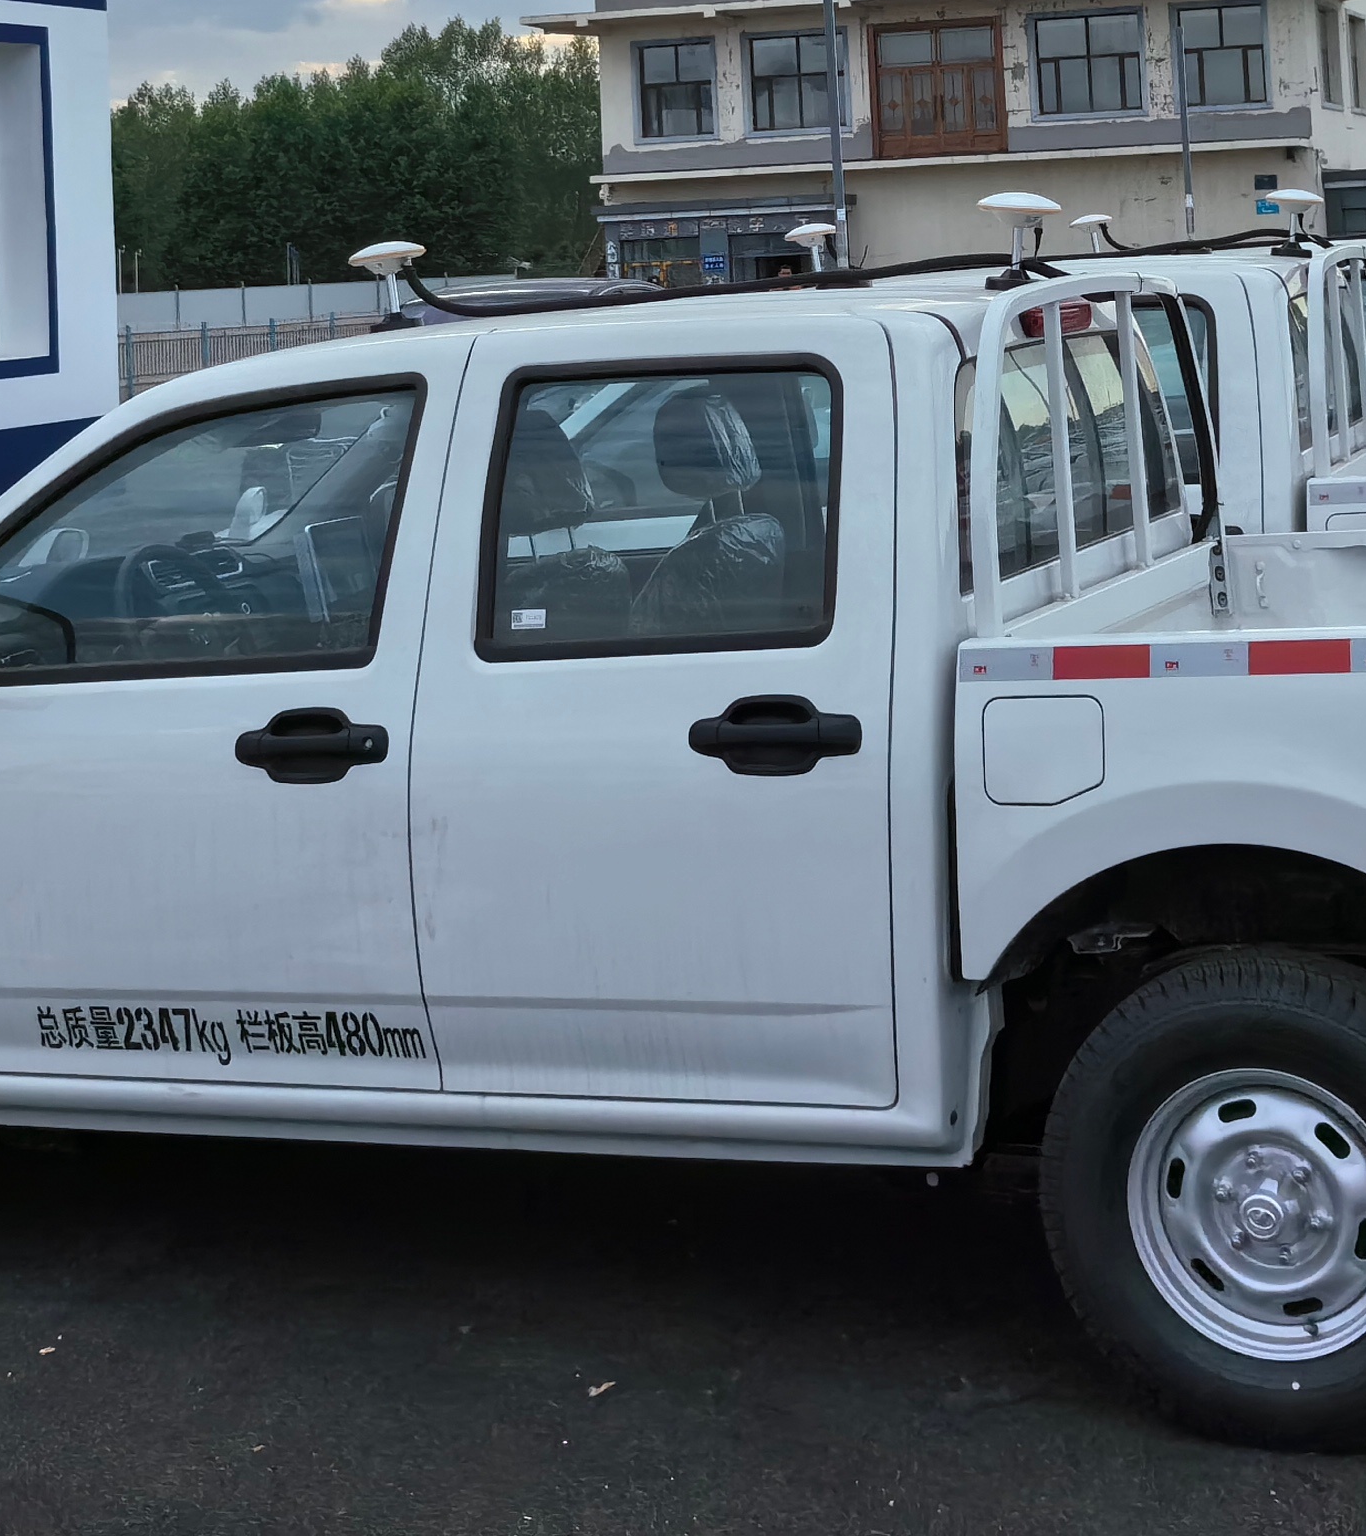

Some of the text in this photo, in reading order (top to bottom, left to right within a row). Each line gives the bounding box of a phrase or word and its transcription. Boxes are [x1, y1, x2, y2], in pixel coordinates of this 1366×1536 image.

[36, 1005, 427, 1066] 总质量2347kg 栏板高480mm
